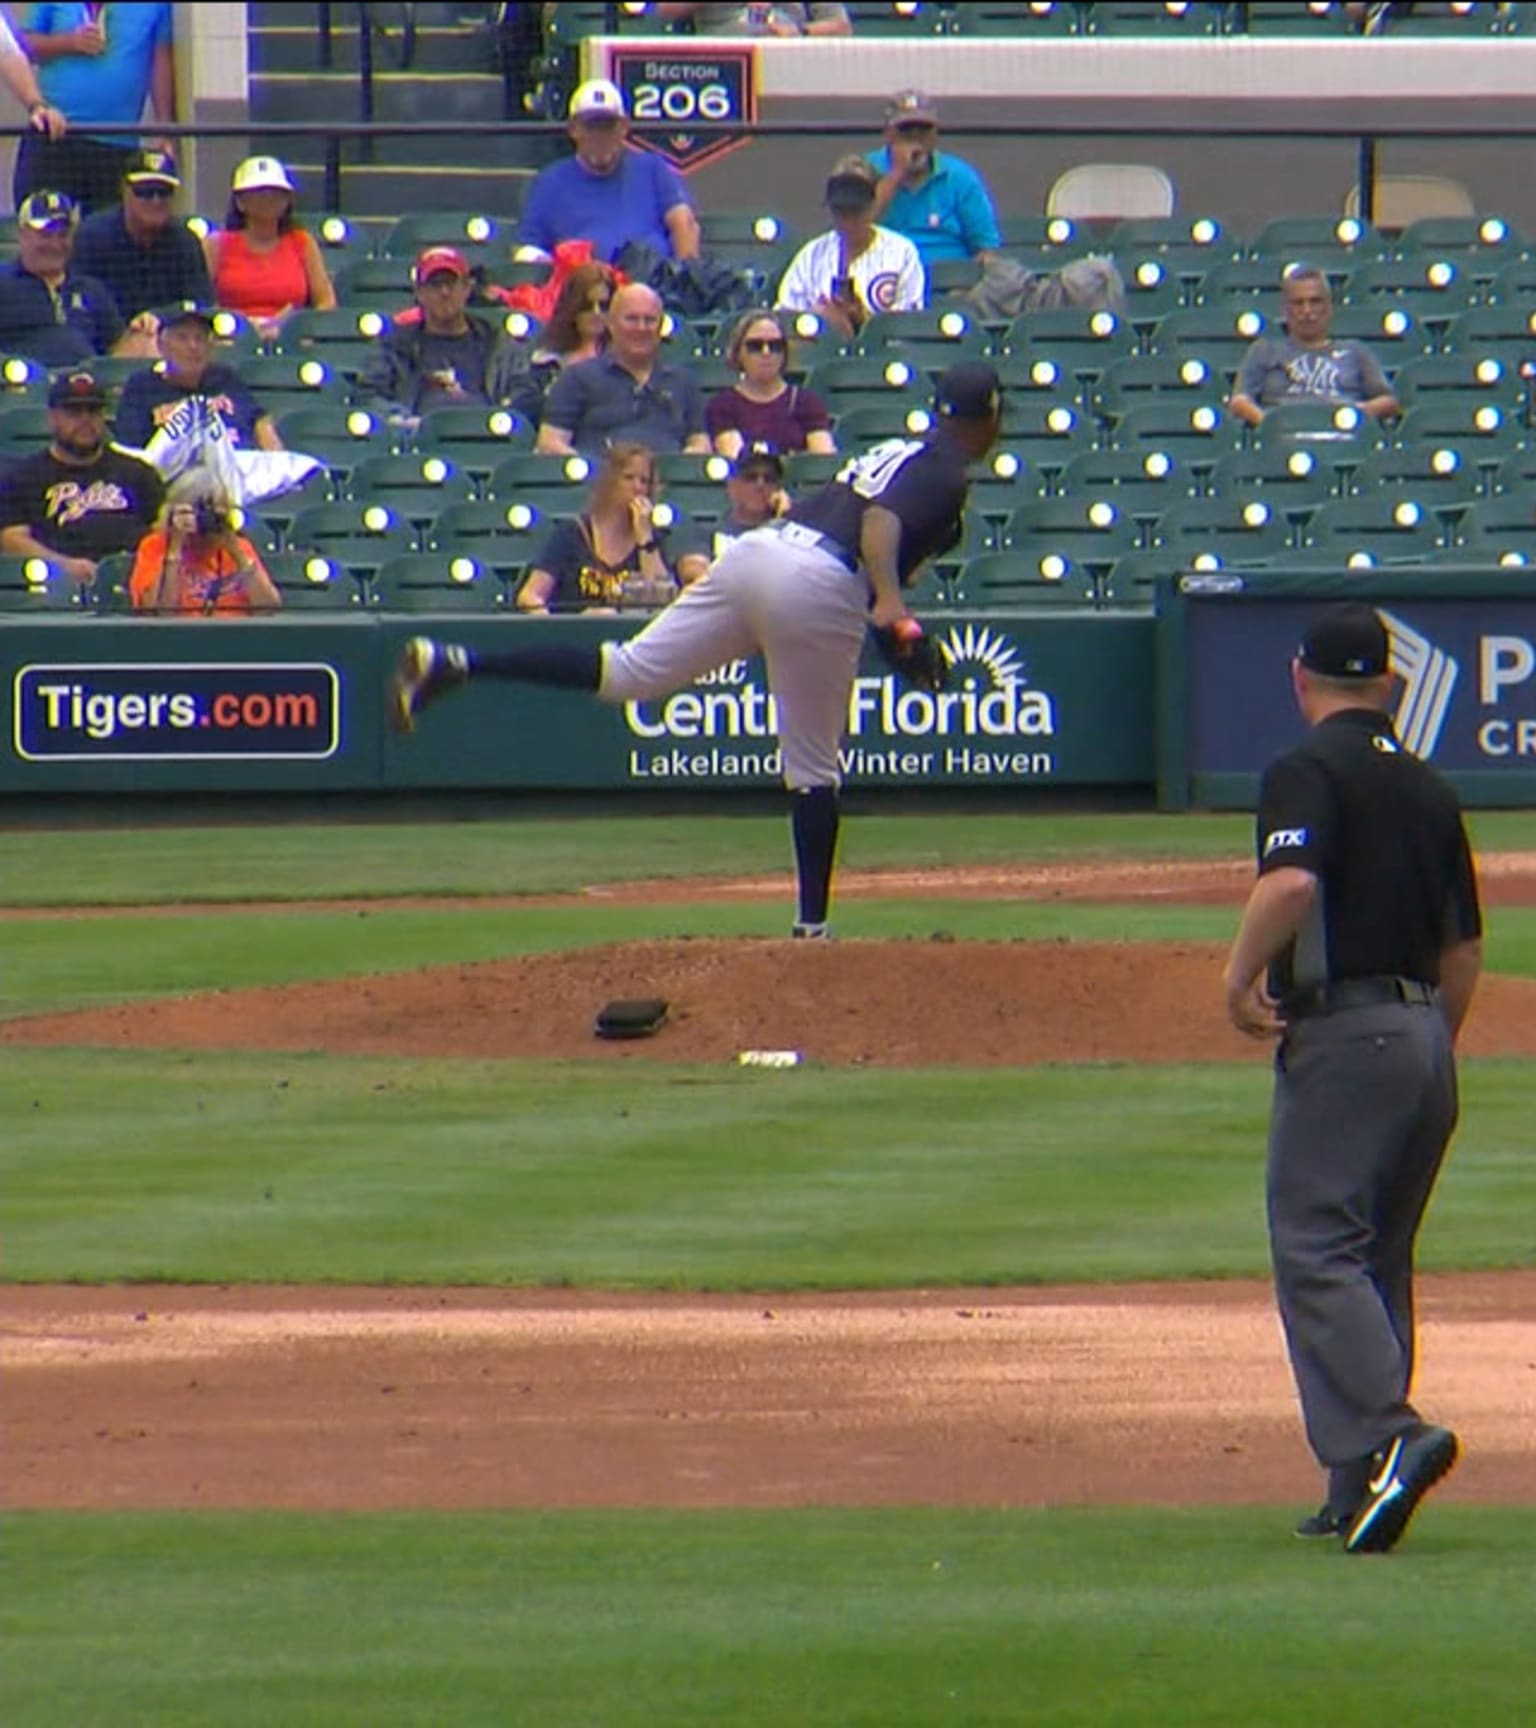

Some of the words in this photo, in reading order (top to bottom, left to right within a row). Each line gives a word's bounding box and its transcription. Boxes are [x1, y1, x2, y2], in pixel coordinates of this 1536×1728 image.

[633, 83, 730, 118] 206
[37, 685, 318, 739] Tigers.com
[624, 682, 779, 738] Cent
[849, 674, 1054, 735] Florida
[630, 748, 783, 777] Lakeland
[945, 748, 1052, 774] Haven
